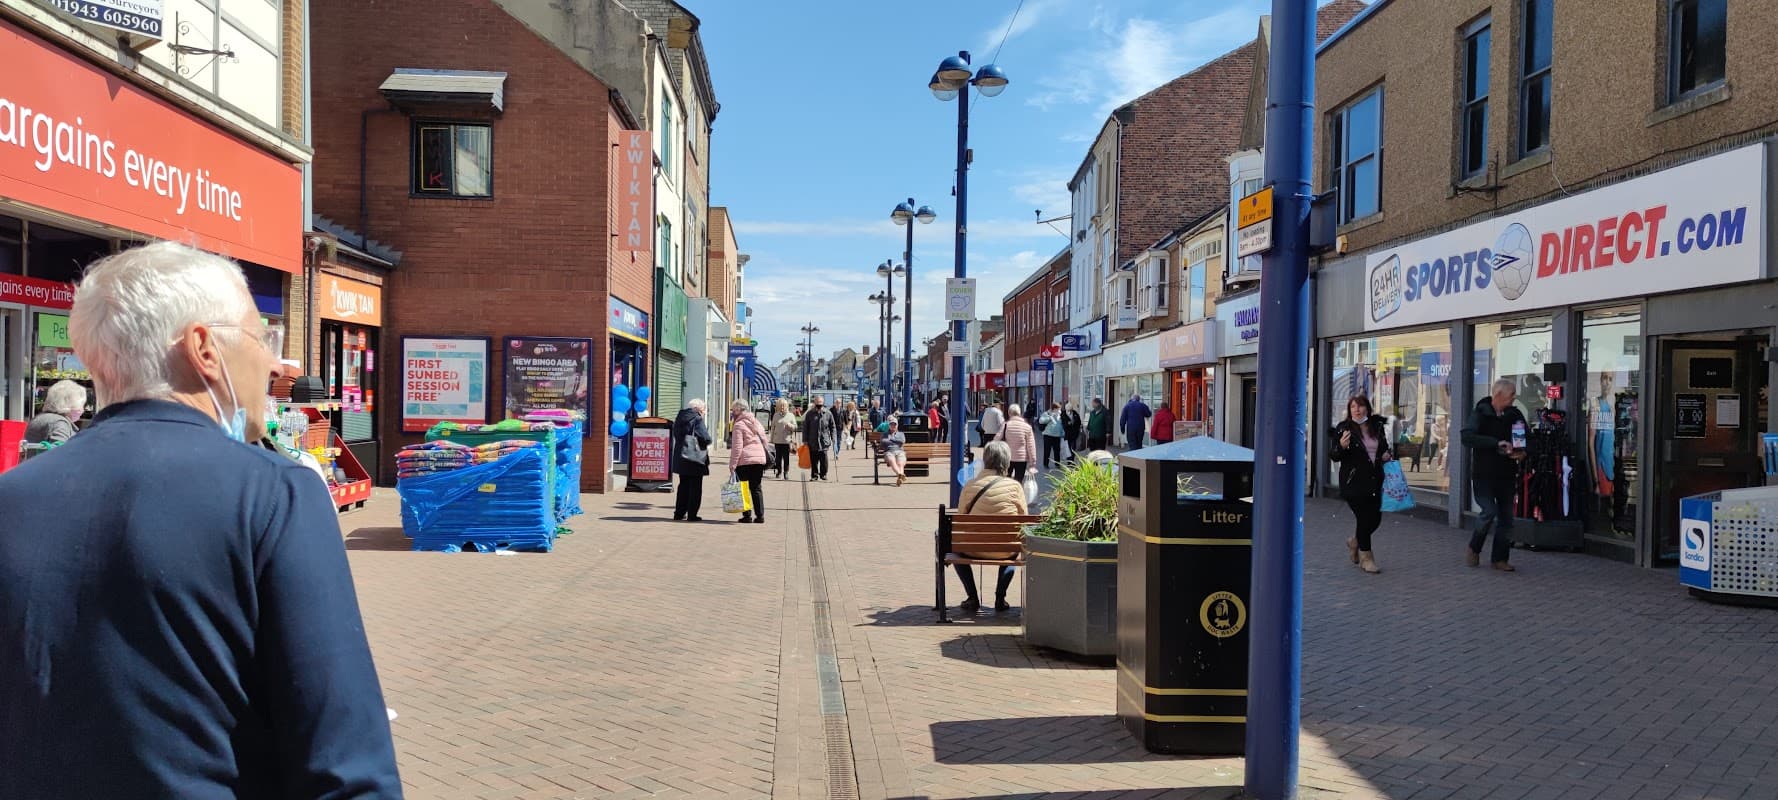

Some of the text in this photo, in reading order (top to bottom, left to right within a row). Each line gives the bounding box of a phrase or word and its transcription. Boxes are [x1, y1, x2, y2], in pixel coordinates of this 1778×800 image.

[103, 9, 159, 33] 605960
[124, 148, 191, 215] every
[196, 168, 242, 221] time
[627, 134, 644, 247] KWIK TAN
[1374, 265, 1399, 297] 24HR
[1404, 247, 1493, 302] SPORTS
[25, 284, 49, 303] every
[1373, 288, 1401, 311] DELIVERY
[407, 359, 443, 369] FIRST
[407, 370, 458, 380] SUNBED
[407, 381, 460, 391] SESSION
[634, 449, 665, 458] OPEN!
[635, 441, 665, 450] WE'RE
[635, 465, 665, 473] INSIDE
[1202, 510, 1243, 523] Litter
